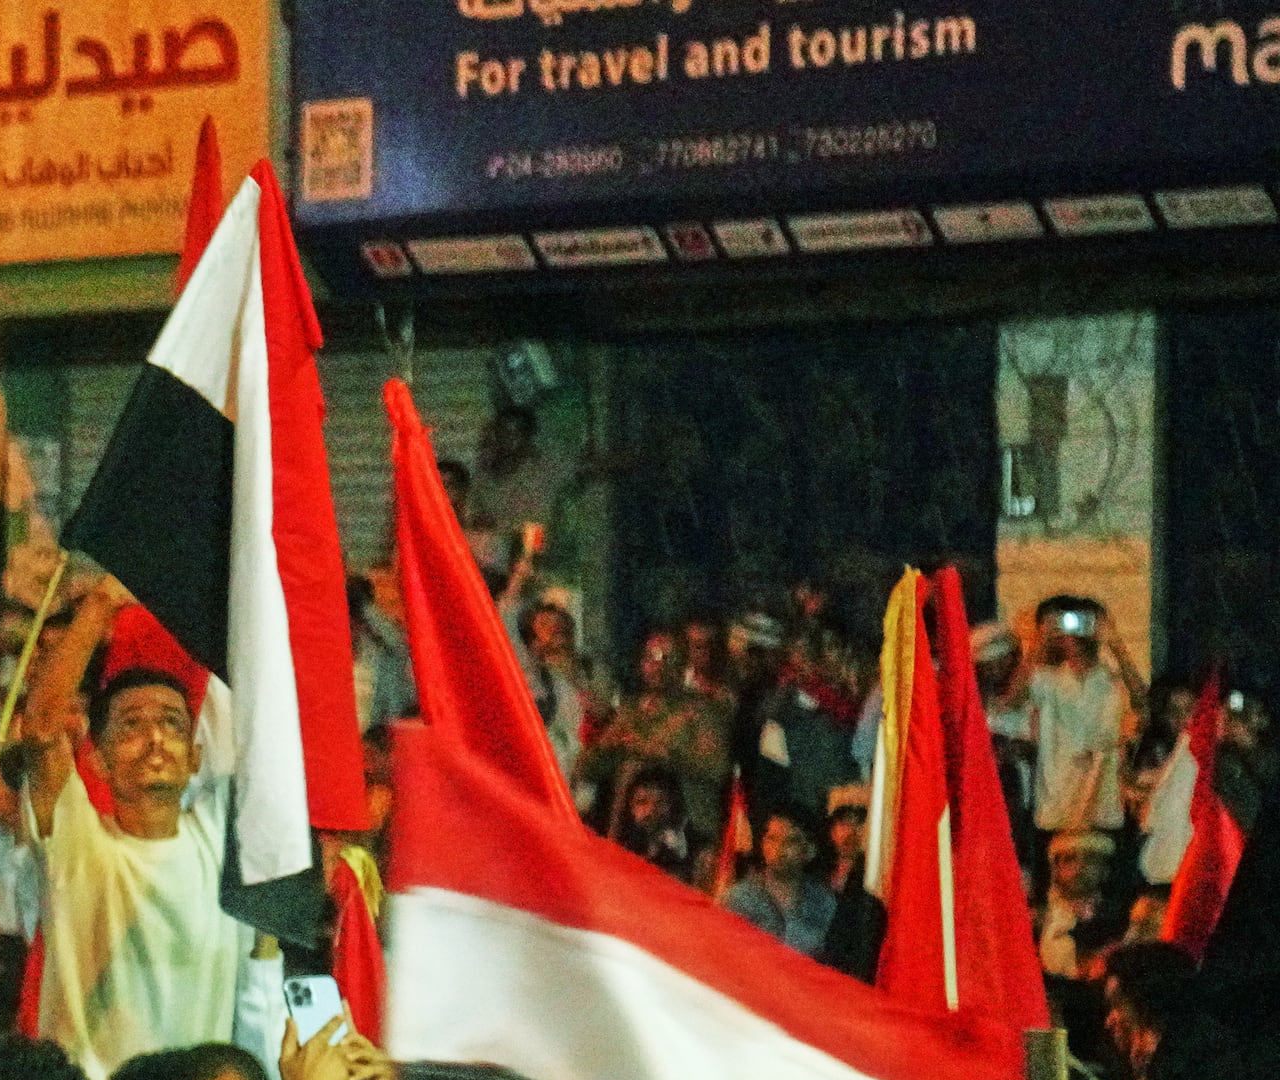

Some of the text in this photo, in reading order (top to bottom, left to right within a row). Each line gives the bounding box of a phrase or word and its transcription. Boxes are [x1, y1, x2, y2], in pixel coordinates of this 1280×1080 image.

[456, 51, 525, 98] For
[541, 33, 669, 91] travel
[683, 23, 771, 80] and
[788, 12, 977, 70] tourism
